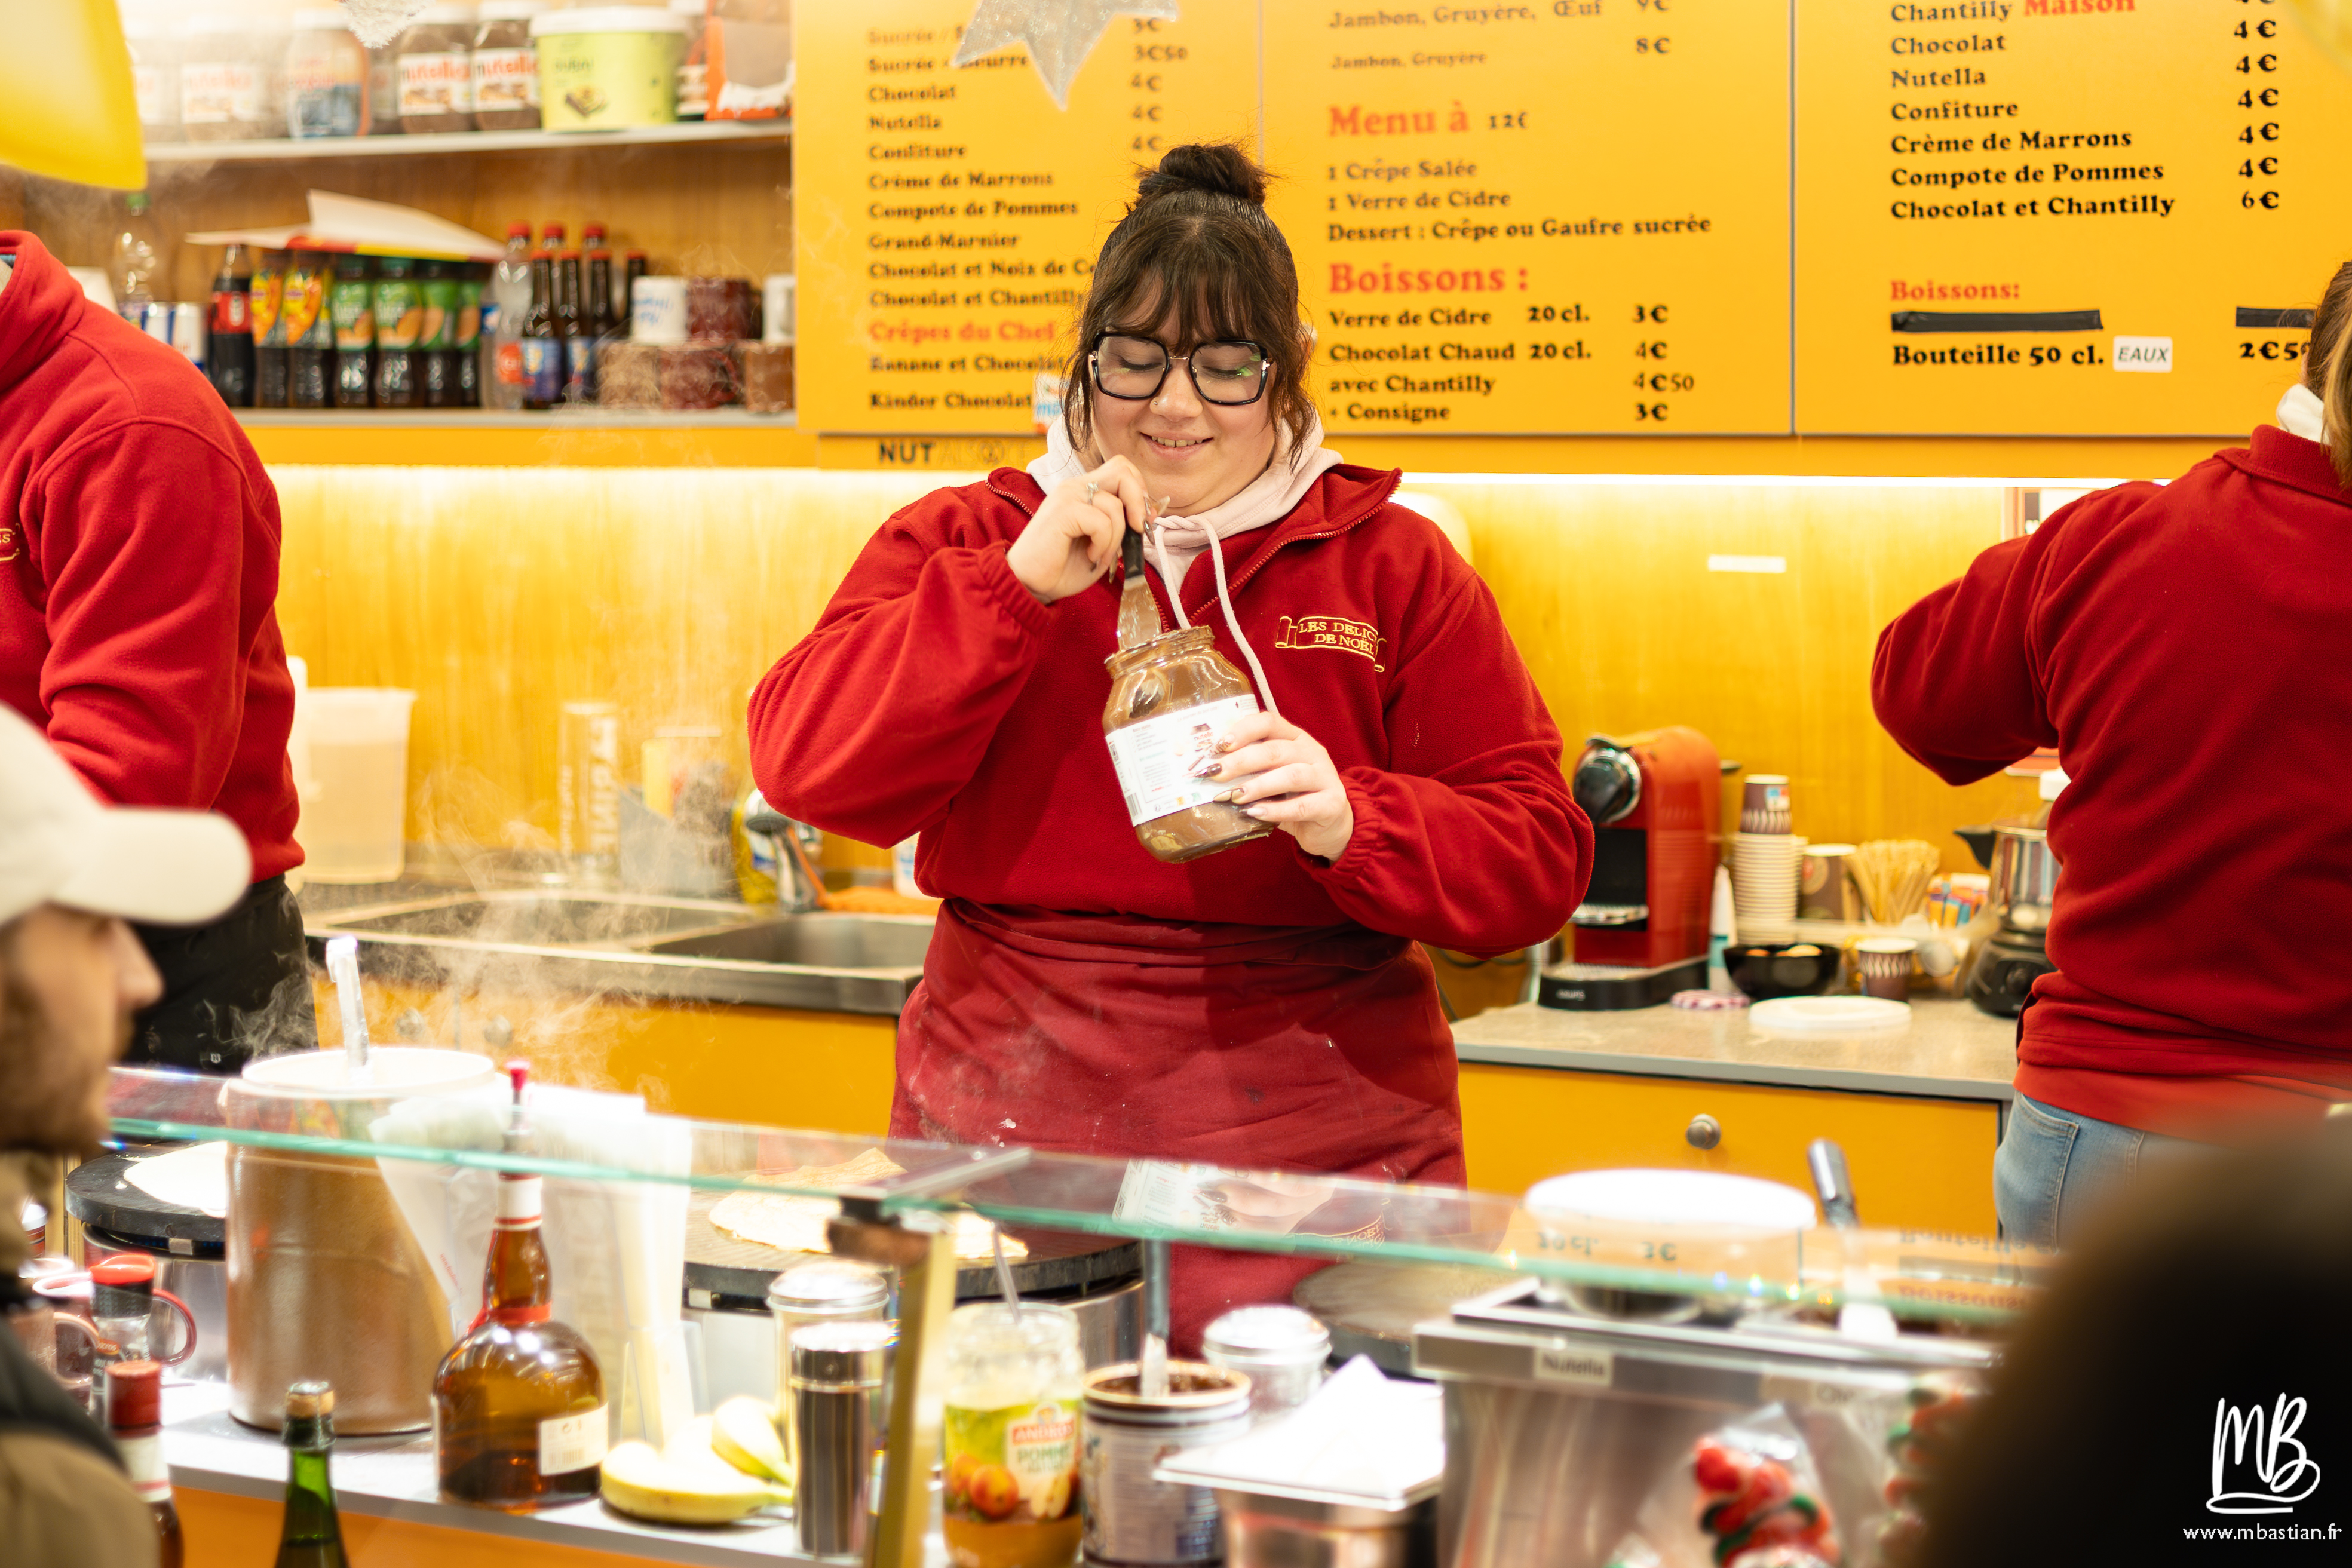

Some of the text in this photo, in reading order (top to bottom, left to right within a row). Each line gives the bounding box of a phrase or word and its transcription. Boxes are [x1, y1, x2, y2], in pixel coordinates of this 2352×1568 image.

[1328, 10, 1427, 29] Jambon,
[1432, 4, 1537, 26] Gruyère,
[1891, 0, 2135, 22] Chantilly Maison
[1636, 37, 1670, 54] 8€
[1891, 20, 2276, 56] Chocolat 4€
[1891, 54, 2277, 88] Nutella 4€
[867, 85, 956, 103] Chocolat
[1891, 88, 2279, 121] Confiture 4€
[868, 114, 942, 131] Nutella
[1329, 105, 1436, 137] Menu
[1448, 100, 1470, 133] à
[1890, 122, 2279, 154] Crème de Marrons 4€
[867, 143, 967, 161] Confiture
[938, 173, 960, 188] de
[967, 171, 1054, 188] Marrons
[1329, 158, 1477, 183] 1 Crêpe Salée
[1891, 157, 2278, 189] Compote de Pommes 4€
[868, 200, 1078, 222] Compote de Pommes
[1329, 190, 1511, 211] 1 Verre de Cidre
[1891, 191, 2279, 219] Chocolat et Chantilly 6€
[1327, 223, 1411, 242] Dessert
[1431, 219, 1499, 243] Crêpe
[1505, 224, 1534, 238] ou
[1541, 217, 1623, 237] Gaufre
[1633, 214, 1711, 235] sucrée
[868, 262, 957, 279] Chocolat
[965, 262, 980, 276] et
[989, 260, 1036, 277] Noix
[1042, 260, 1066, 277] de
[1329, 262, 1505, 294] Boissons
[870, 291, 958, 307] Chocolat
[965, 291, 980, 305] et
[1891, 280, 2019, 301] Boissons:
[1329, 303, 1667, 327] Verre de Cidre 20 cl. 3€
[958, 321, 992, 342] du
[999, 320, 1055, 340] Chef
[1328, 340, 1667, 363] Chocolat Chaud 20 cl. 4€
[1893, 345, 2103, 367] Bouteille 50 cl.
[2118, 346, 2168, 363] EAUX
[870, 354, 1064, 373] Banane et Chocolat
[1330, 380, 1378, 393] avec
[1384, 374, 1495, 396] Chantilly
[869, 392, 1032, 409] Kinder Chocolat
[1347, 403, 1450, 424] Consigne
[1636, 403, 1667, 421] 3€
[1299, 622, 1326, 633] LES
[1315, 633, 1374, 655] DE NOËL
